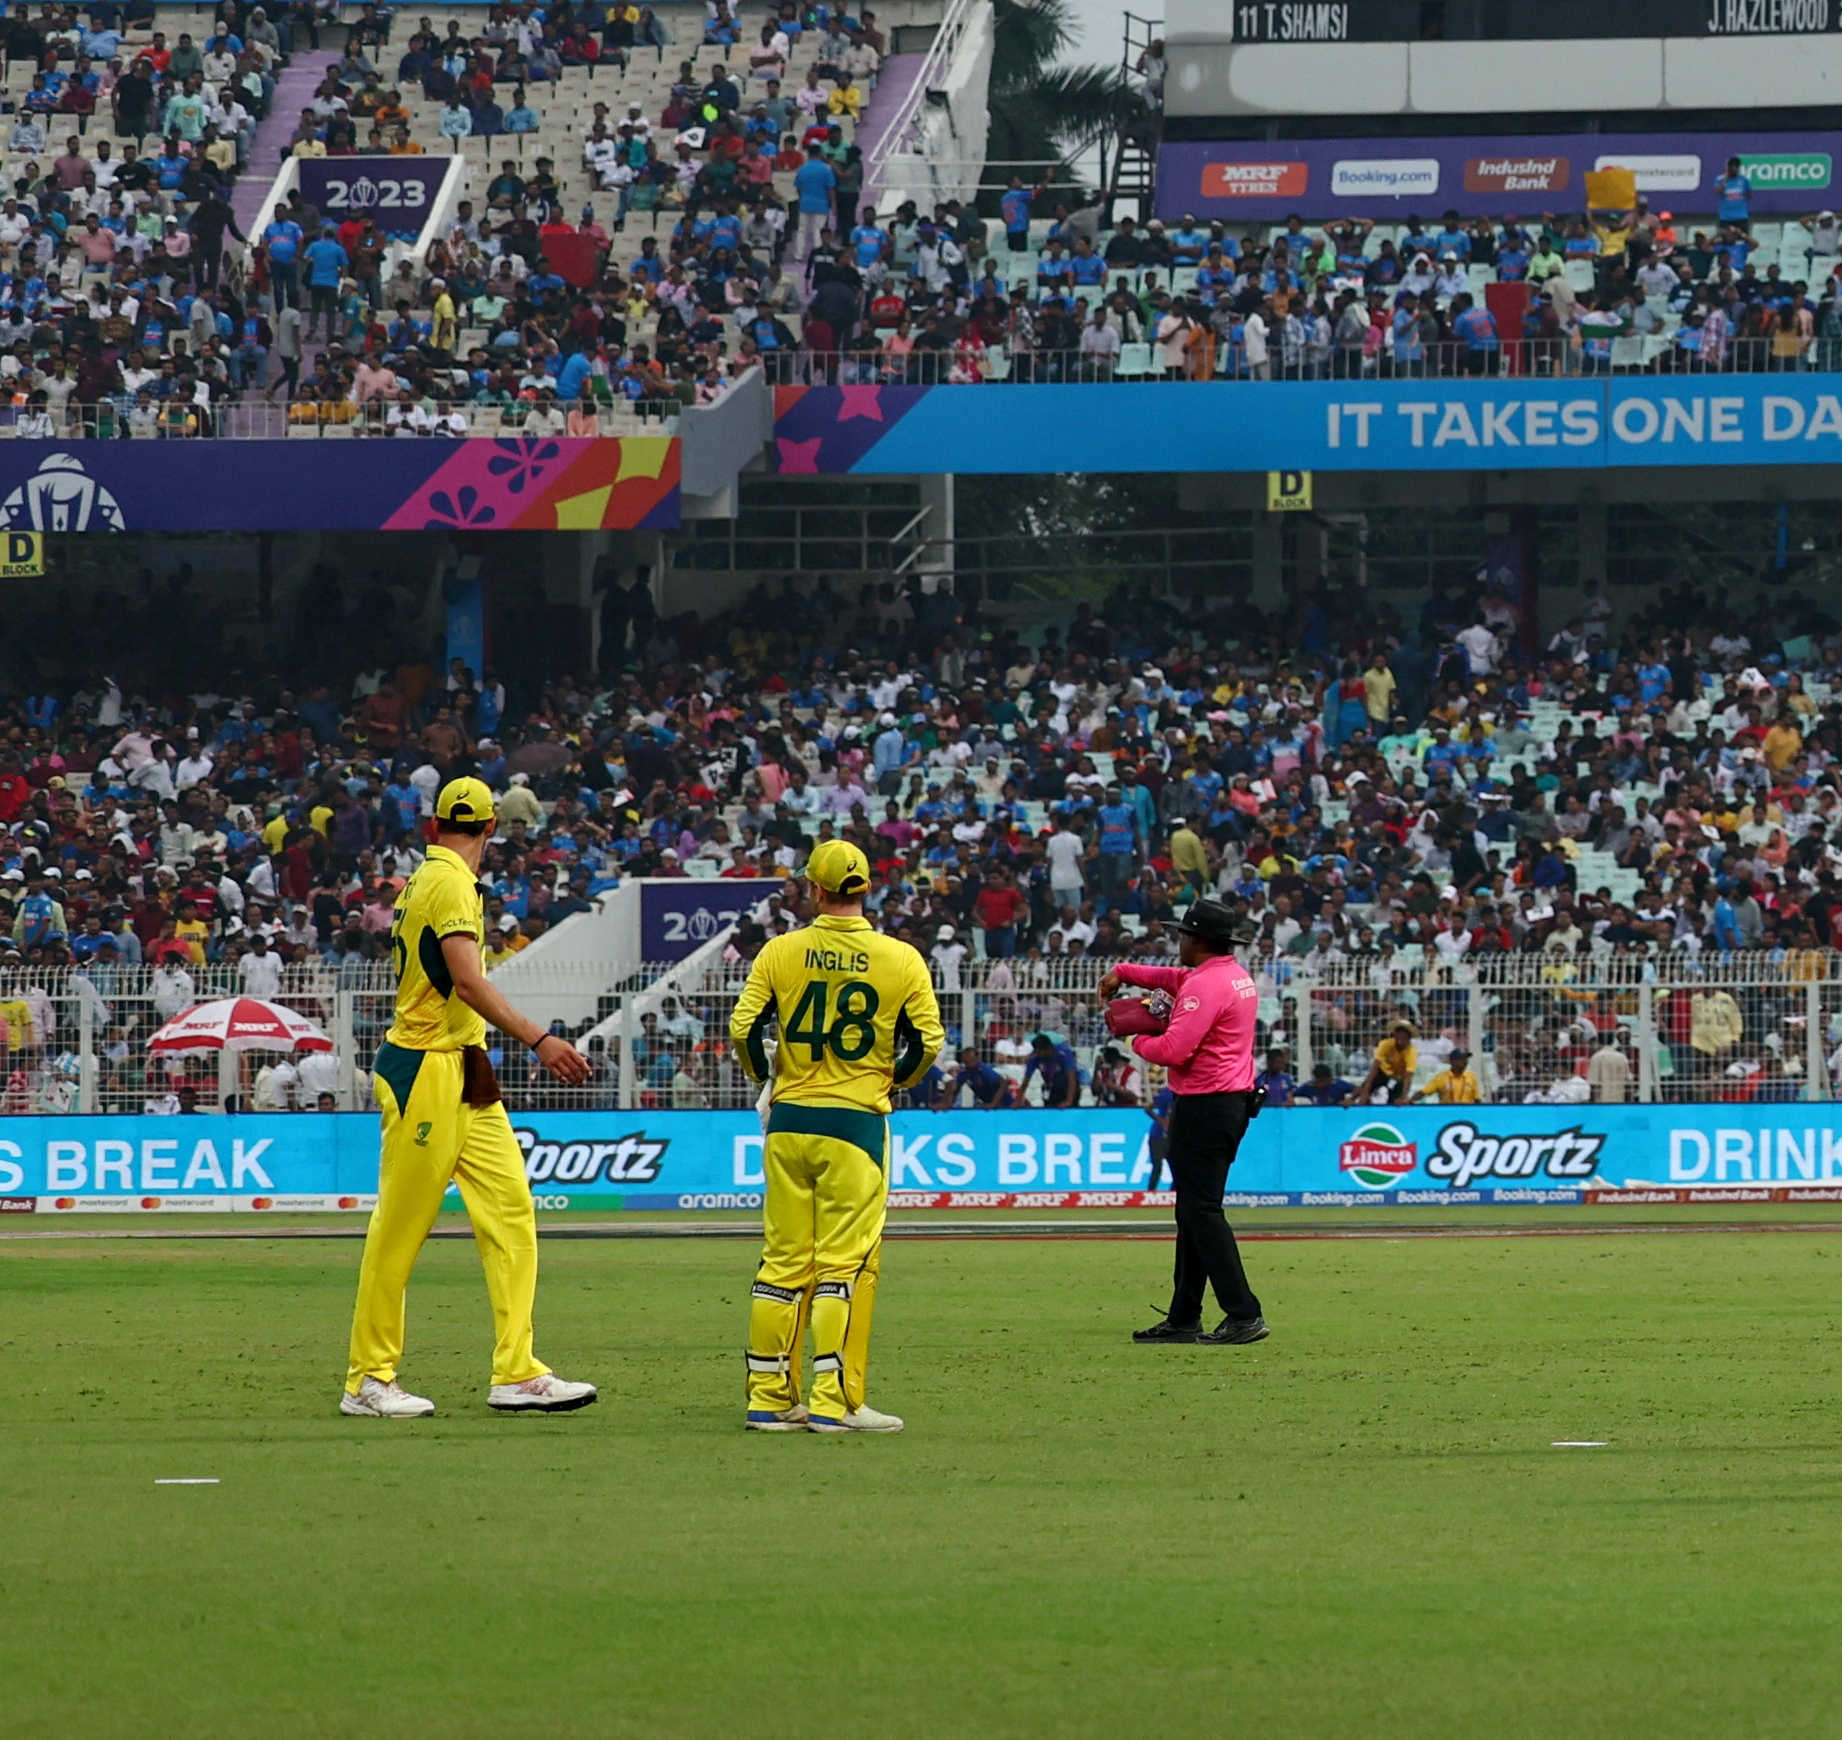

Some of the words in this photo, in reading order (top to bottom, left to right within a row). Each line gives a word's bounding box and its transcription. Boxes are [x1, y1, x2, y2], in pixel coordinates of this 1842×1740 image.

[1239, 5, 1258, 37] 11
[1222, 165, 1288, 181] MRF
[1478, 159, 1557, 176] IndusInd
[1339, 170, 1432, 184] Booking.com
[1504, 174, 1549, 190] Bank
[1327, 402, 1383, 448] IT
[1397, 399, 1599, 447] TAKES
[1611, 396, 1744, 444] ONE
[1280, 470, 1304, 497] D
[9, 533, 34, 563] D
[2, 564, 38, 575] BLOCK
[805, 948, 869, 973] INGLIS
[786, 980, 880, 1062] 48
[998, 1132, 1174, 1186] BREA
[1341, 1144, 1414, 1165] Limca
[1427, 1124, 1604, 1187] Sportz
[46, 1138, 276, 1191] BREAK
[678, 1192, 761, 1209] aramco
[887, 1193, 941, 1207] MRF
[947, 1193, 1007, 1207] MRF
[1012, 1192, 1070, 1207] MRF
[1076, 1192, 1134, 1206] MRF
[1301, 1191, 1385, 1205] Booking.com
[1397, 1190, 1481, 1204] Booking.com
[1493, 1188, 1577, 1203] Booking.com
[1649, 1190, 1677, 1202] Bank
[1742, 1189, 1770, 1202] Bank
[1, 1199, 33, 1211] Bank
